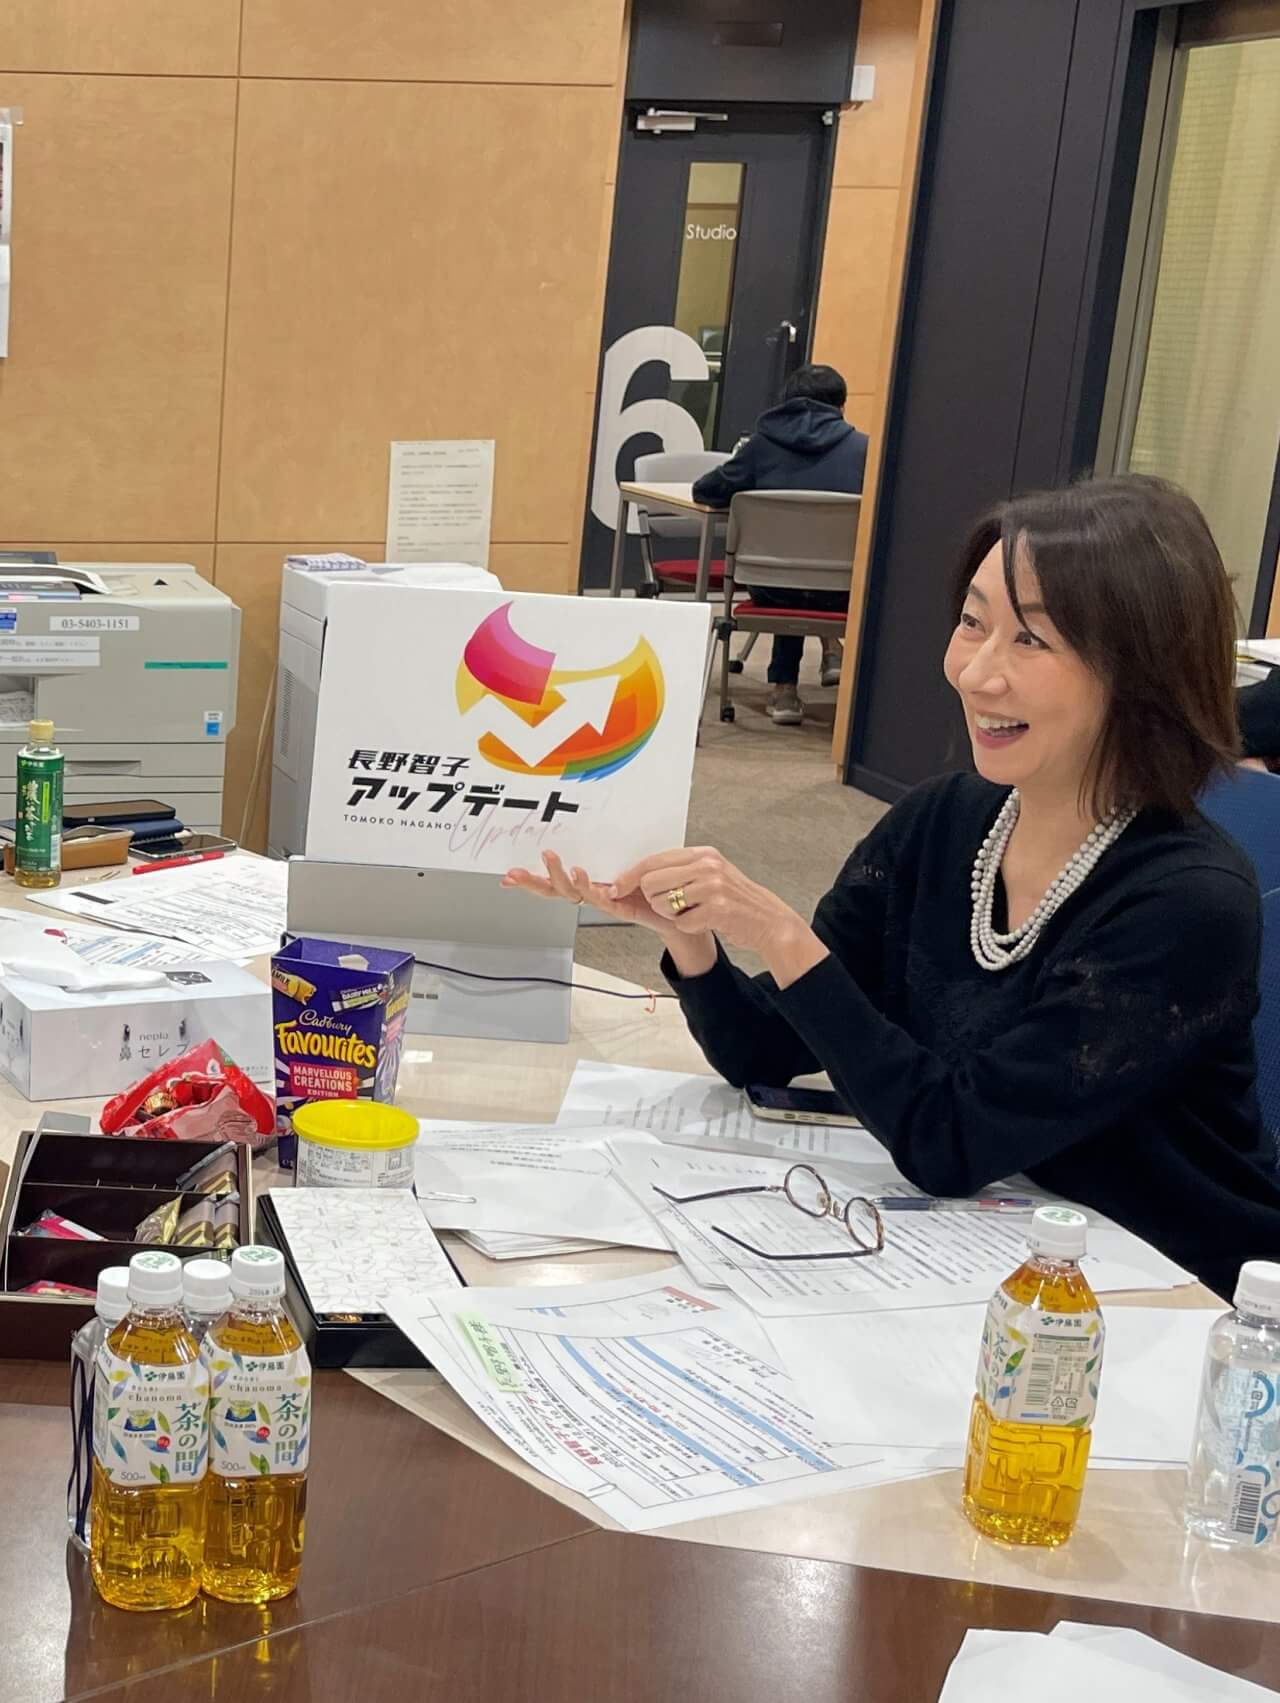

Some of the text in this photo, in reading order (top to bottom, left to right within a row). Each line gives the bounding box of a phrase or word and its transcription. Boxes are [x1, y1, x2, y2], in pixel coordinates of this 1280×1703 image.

[685, 223, 737, 240] Studio
[591, 325, 709, 535] 6
[61, 618, 130, 630] 03-5403-1151
[349, 749, 471, 777] 長野智子
[347, 776, 580, 822] アップデート
[343, 814, 394, 826] TOMOKO
[449, 800, 570, 861] Update
[299, 1008, 353, 1034] Cadbury
[274, 1019, 378, 1069] Favourites
[293, 1065, 352, 1080] MARVELLOUS
[293, 1075, 353, 1092] CREATIONS
[307, 1088, 339, 1098] EDITION
[259, 1361, 285, 1371] 伊藤園
[158, 1370, 186, 1381] 伊藤園
[128, 1392, 182, 1402] chanoma
[230, 1384, 282, 1393] chanoma
[272, 1392, 303, 1467] 茶の間
[172, 1401, 202, 1477] 茶の間
